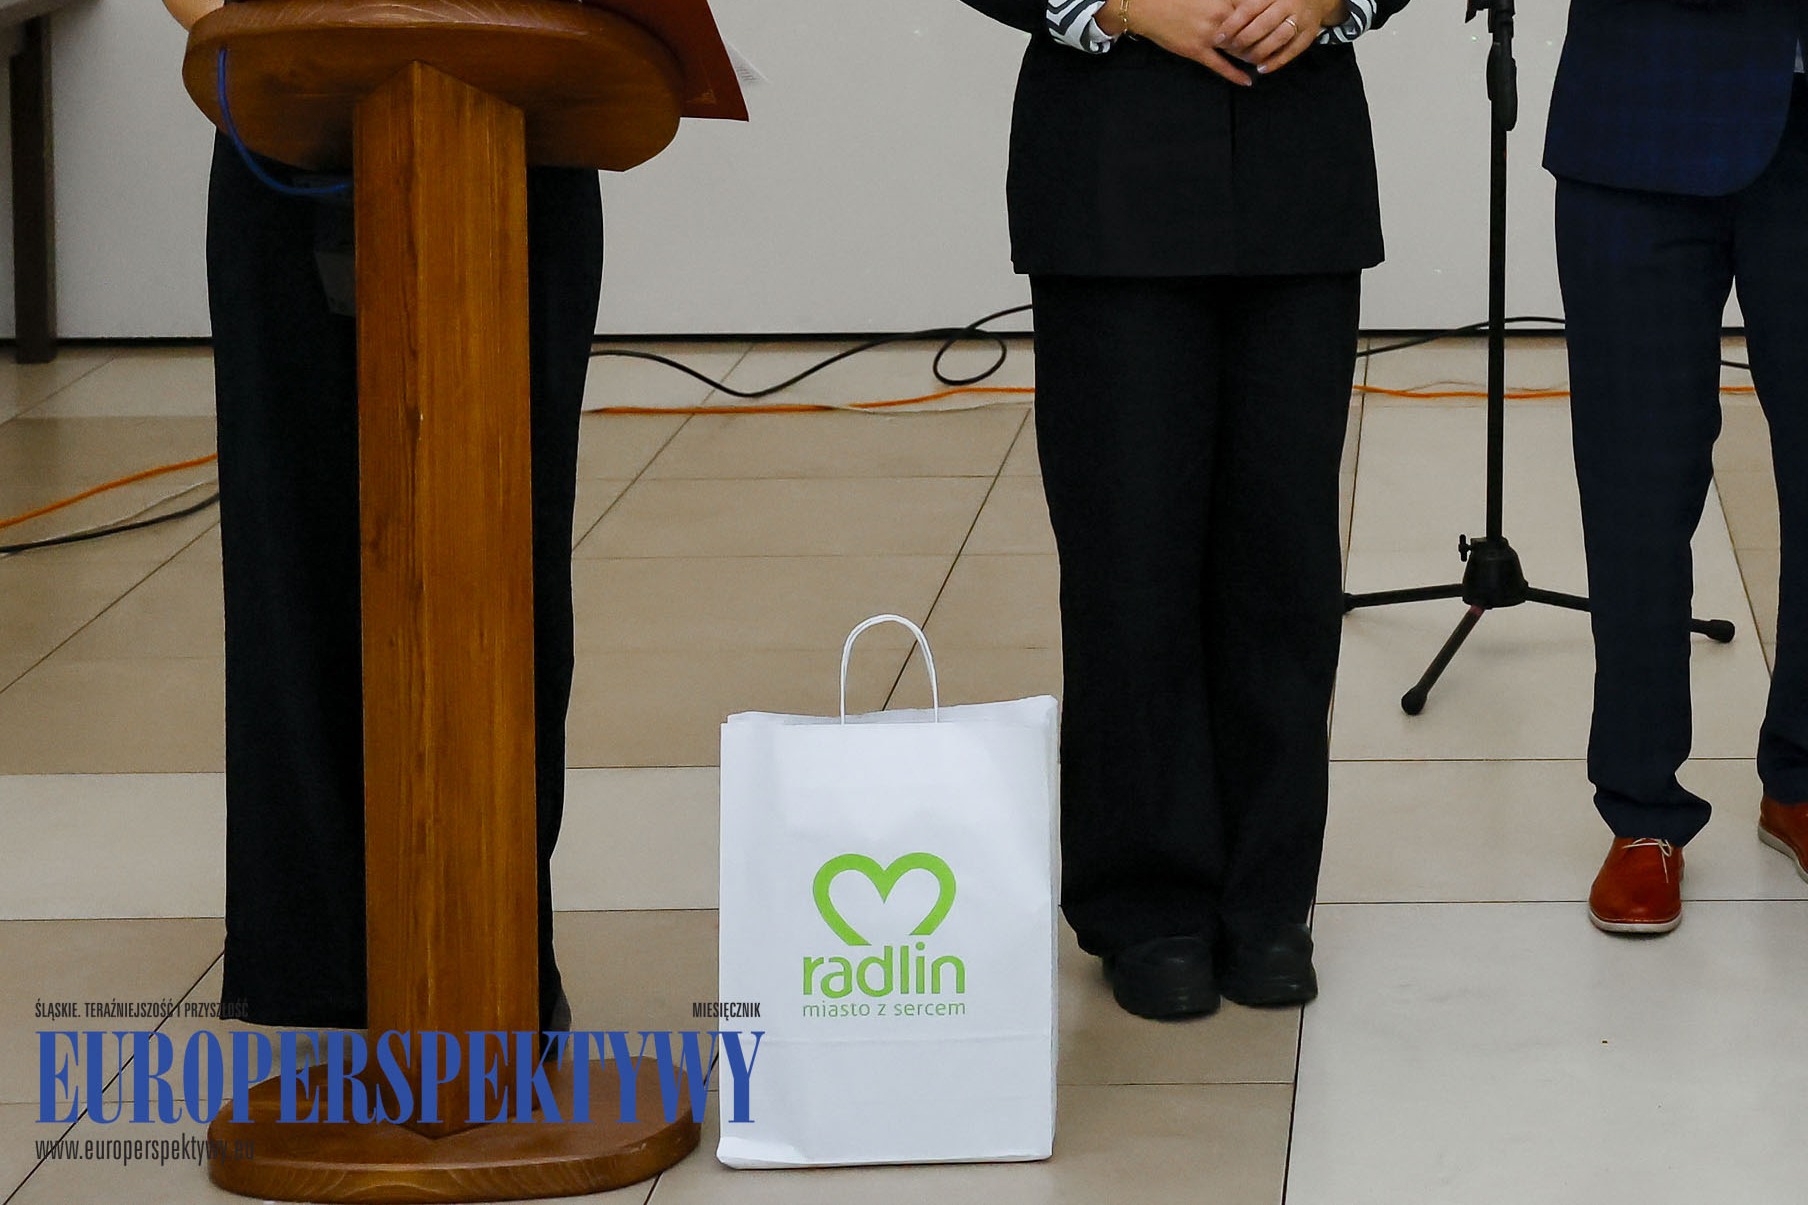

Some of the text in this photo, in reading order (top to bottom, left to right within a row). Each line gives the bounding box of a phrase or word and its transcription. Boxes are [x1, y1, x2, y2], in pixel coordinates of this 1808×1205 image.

[803, 941, 966, 999] radlin
[803, 1000, 966, 1017] miasto z sercem
